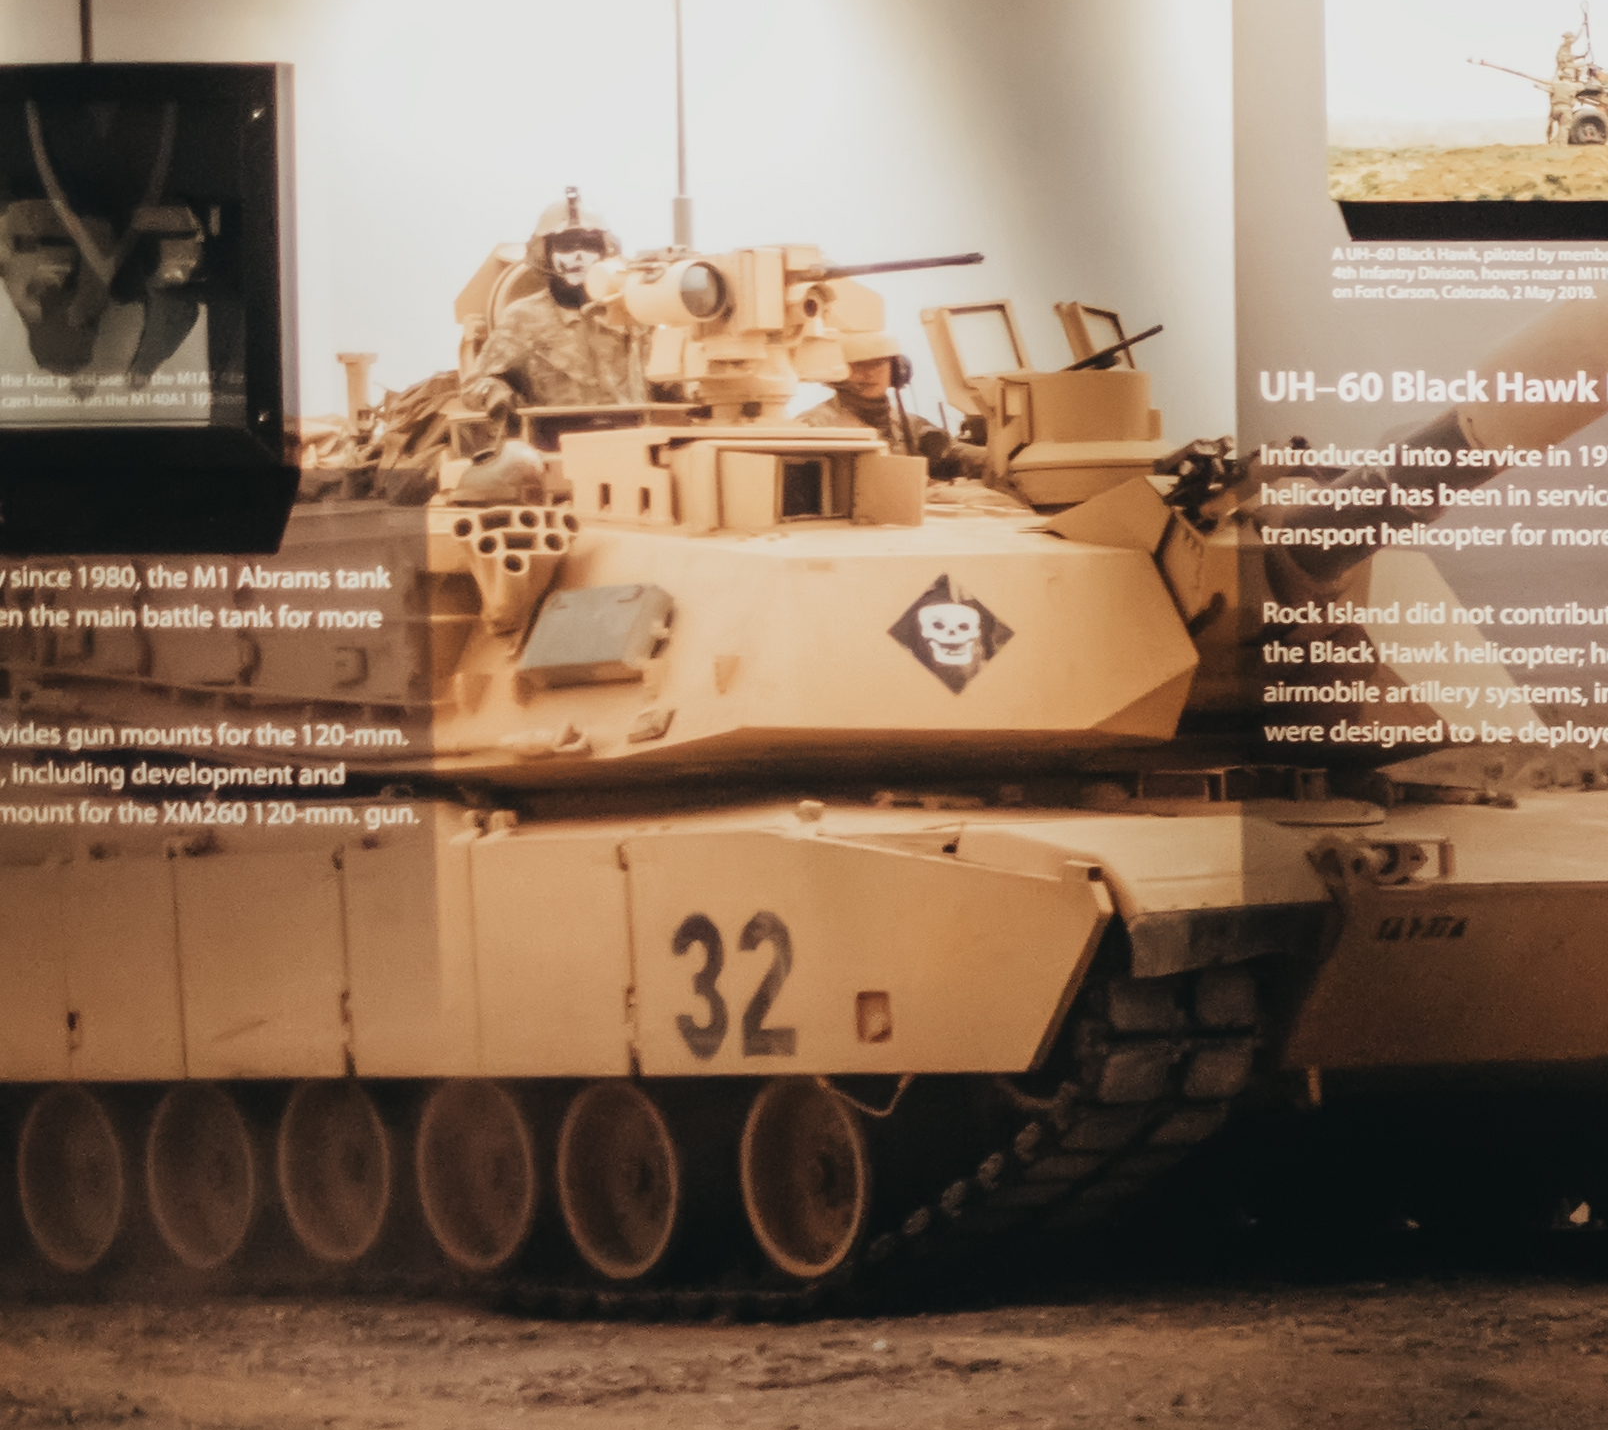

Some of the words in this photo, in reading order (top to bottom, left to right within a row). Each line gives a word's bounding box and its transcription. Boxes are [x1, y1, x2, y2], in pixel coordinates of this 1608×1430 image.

[1331, 287, 1354, 299] on
[1353, 284, 1385, 299] Fort
[1385, 284, 1441, 301] Carson,
[1440, 284, 1511, 301] Colorado,
[1512, 285, 1523, 300] 2
[1523, 285, 1556, 303] May
[1556, 285, 1597, 300] 2019.
[1259, 370, 1383, 402] UH–60
[1392, 370, 1490, 403] Black
[1496, 369, 1600, 404] Hawk
[1260, 444, 1396, 467] Introduced
[1400, 443, 1453, 468] into
[1454, 444, 1543, 468] service
[1547, 444, 1571, 467] in
[1261, 483, 1386, 511] helicopter
[1387, 481, 1435, 508] has
[1437, 482, 1502, 507] been
[1507, 484, 1531, 506] in
[1261, 525, 1376, 550] transport
[1380, 521, 1506, 551] helicopter
[1510, 522, 1546, 546] for
[9, 565, 73, 590] since
[77, 564, 142, 592] 1980,
[146, 564, 188, 590] the
[192, 564, 228, 589] M1
[236, 564, 331, 590] Abrams
[335, 565, 392, 590] tank
[28, 603, 71, 629] the
[75, 605, 137, 628] main
[141, 603, 215, 629] battle
[217, 603, 274, 629] tank
[277, 604, 313, 629] for
[317, 609, 383, 629] more
[0, 720, 63, 747] vides
[66, 726, 116, 752] gun
[119, 725, 213, 746] mounts
[215, 721, 252, 746] for
[254, 722, 297, 747] the
[301, 723, 410, 747] 120-mm.
[11, 760, 125, 791] including
[130, 760, 294, 791] development
[298, 761, 347, 786] and
[78, 799, 114, 824] for
[116, 800, 159, 825] the
[162, 798, 248, 825] XM260
[253, 801, 360, 826] 120-mm.
[363, 806, 421, 831] gun.
[671, 909, 797, 1061] 32
